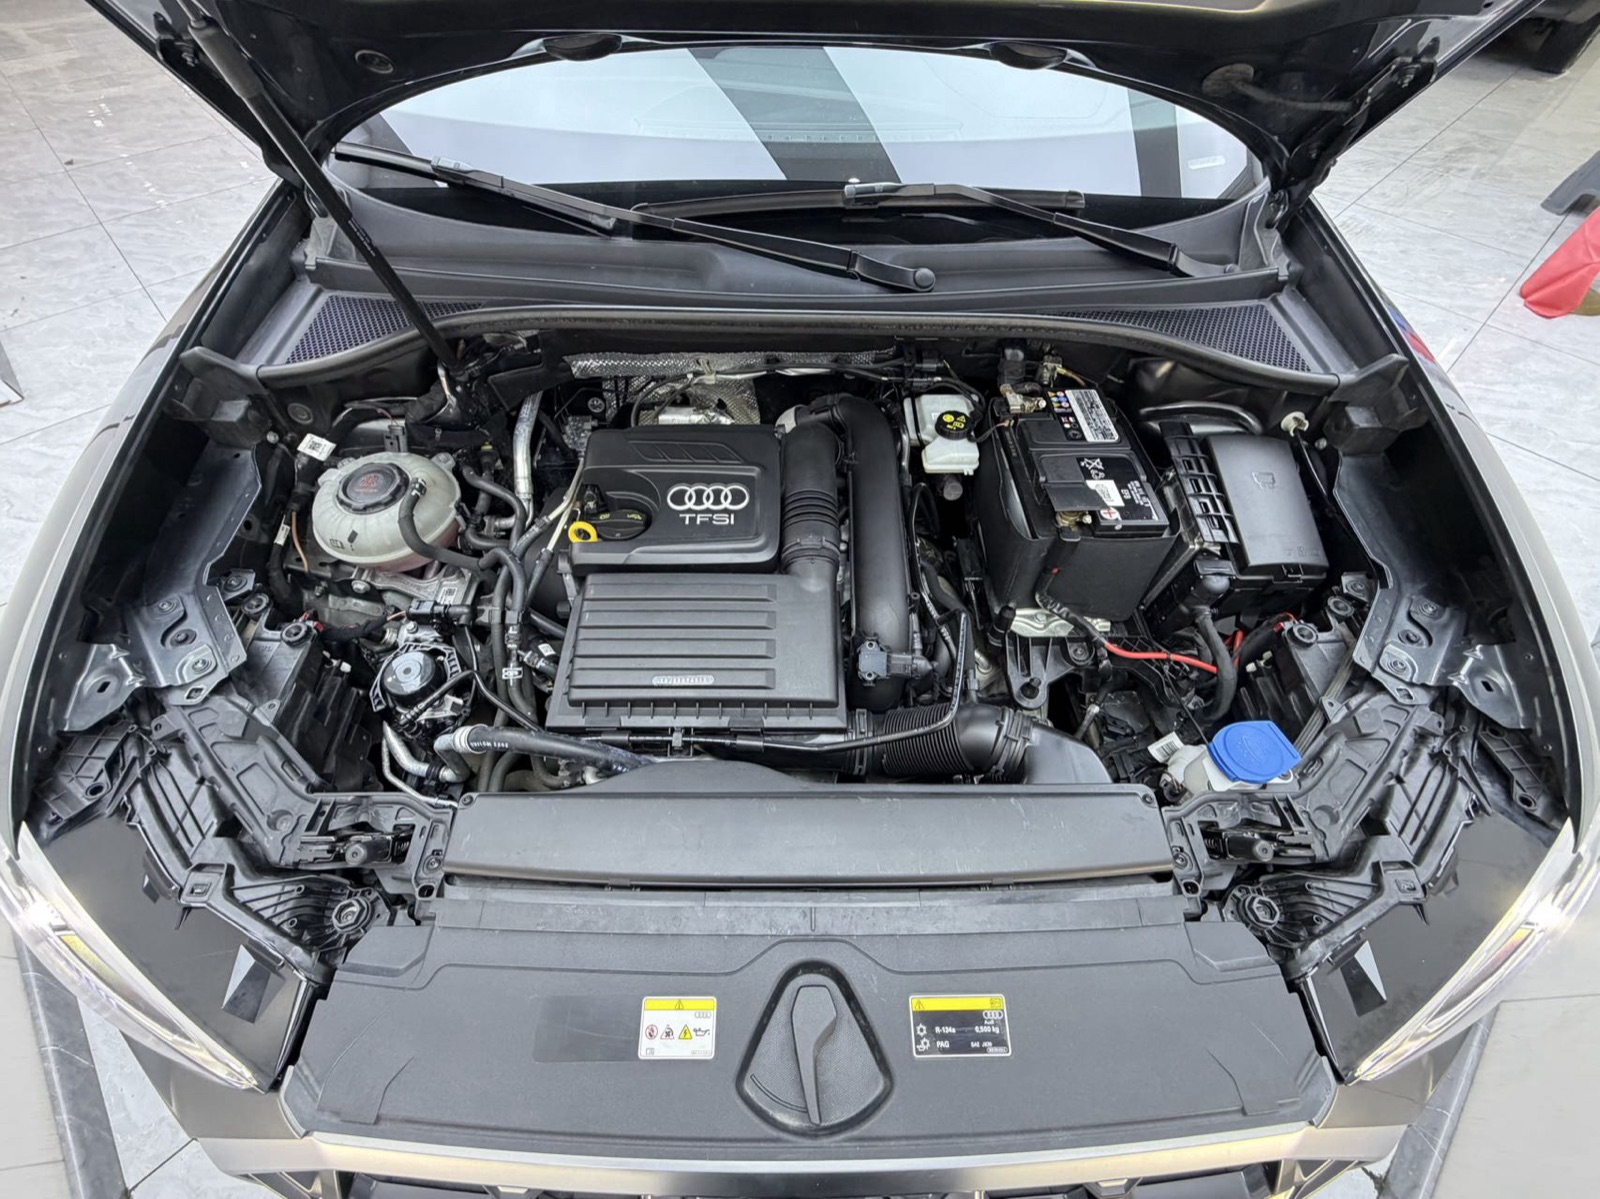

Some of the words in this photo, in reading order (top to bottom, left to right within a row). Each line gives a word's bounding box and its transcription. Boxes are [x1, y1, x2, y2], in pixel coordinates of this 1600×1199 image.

[679, 513, 735, 525] TFSI
[935, 1026, 956, 1034] R-134a
[992, 1025, 999, 1034] kg
[936, 1040, 949, 1048] PAG
